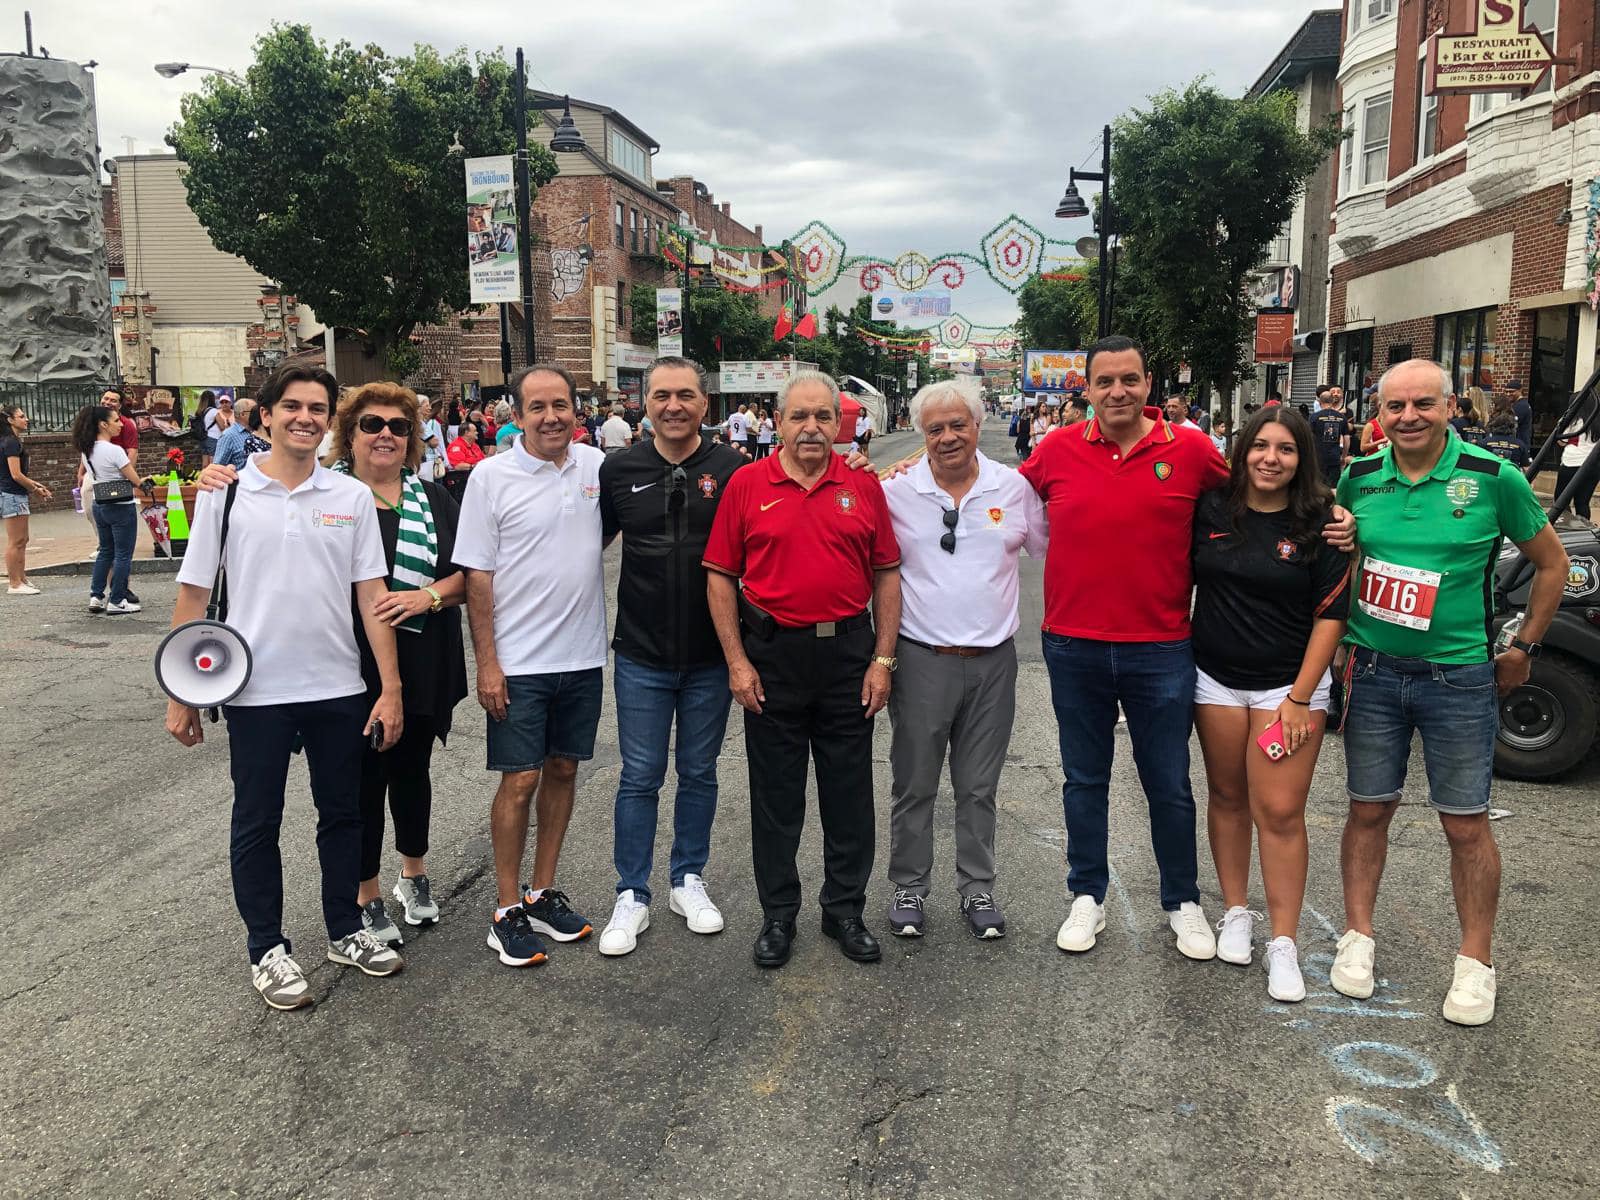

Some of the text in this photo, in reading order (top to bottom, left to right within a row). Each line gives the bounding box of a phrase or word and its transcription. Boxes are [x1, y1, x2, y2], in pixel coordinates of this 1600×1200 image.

[1484, 0, 1514, 26] S
[1453, 38, 1531, 49] RESTAURANT
[1453, 49, 1531, 62] Bar & Grill
[1469, 72, 1531, 82] 589-4070
[472, 174, 510, 185] IRONBOUND
[733, 422, 740, 434] 9
[1360, 486, 1395, 495] macron
[1365, 573, 1419, 614] 1716
